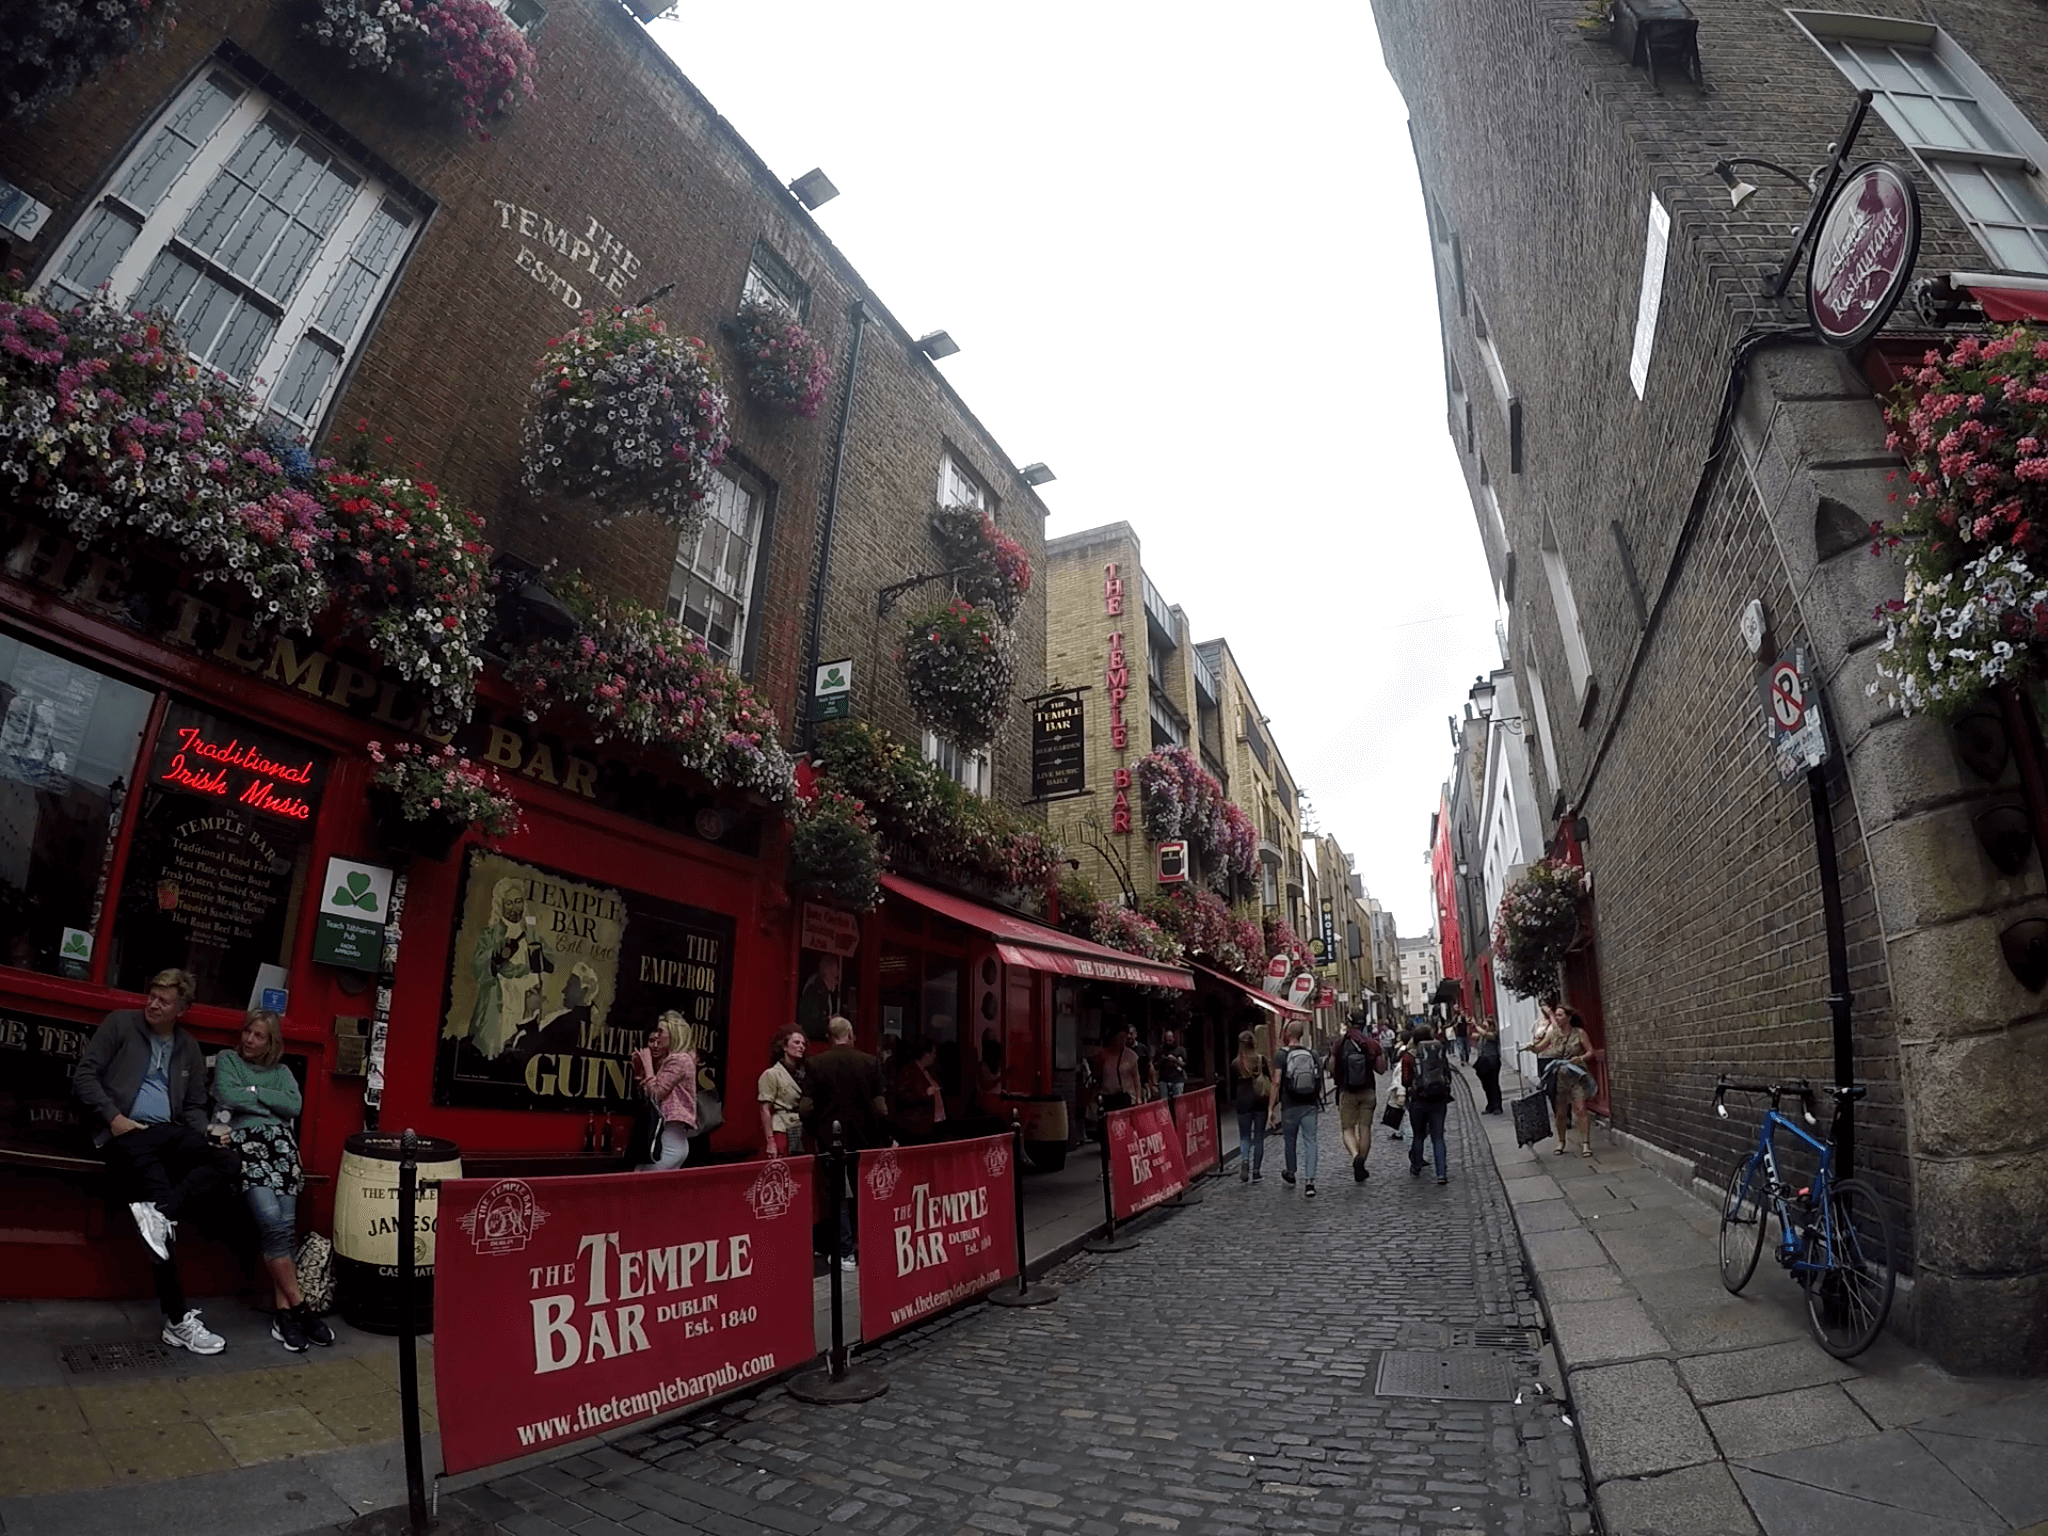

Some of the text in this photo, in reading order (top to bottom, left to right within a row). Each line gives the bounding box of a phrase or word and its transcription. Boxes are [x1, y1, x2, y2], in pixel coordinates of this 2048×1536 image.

[493, 200, 628, 299] TEMPLE
[585, 215, 642, 280] THE
[1829, 207, 1903, 321] Restaurant
[514, 245, 583, 310] ESTD
[1035, 707, 1082, 722] TEMPLE
[1105, 563, 1132, 834] THE TEMPLE BAR
[1045, 720, 1071, 732] BAR
[179, 728, 313, 784] Traditional
[483, 724, 599, 799] BAR
[1055, 768, 1080, 777] MUSIC
[161, 753, 310, 819] Irish Music
[172, 837, 226, 861] Traditional
[228, 853, 251, 868] Food
[176, 817, 246, 837] TEMPLE
[248, 830, 276, 862] BAR
[162, 866, 183, 880] Fresh
[174, 855, 194, 869] Meat
[220, 868, 246, 882] Cheese
[247, 875, 271, 888] Board
[209, 908, 252, 925] Sandwiches
[523, 879, 622, 923] TEMPLE
[172, 912, 188, 924] Hot
[190, 916, 212, 930] Roast
[213, 922, 232, 934] Beef
[550, 910, 598, 943] BAR
[1323, 912, 1334, 961] HOSTEL
[687, 934, 719, 965] THE
[639, 954, 716, 994] EMPEROR
[1073, 958, 1094, 976] THE
[1093, 961, 1127, 980] TEMPLE
[1125, 966, 1142, 981] BAR
[695, 995, 715, 1022] OF
[576, 1020, 646, 1056] MALTE
[29, 1107, 63, 1123] LIVE
[361, 1186, 386, 1200] THE
[490, 1182, 527, 1198] TEMPLE
[522, 1194, 532, 1216] BAR
[893, 1182, 990, 1234] THE TEMPLE
[529, 1231, 755, 1307] THE TEMPLE
[893, 1224, 981, 1278] BAR DUBLIN
[529, 1294, 719, 1374] BAR DUBLIN
[684, 1305, 758, 1340] Est. 1840
[516, 1352, 776, 1447] www.thetemplebarpub.com
